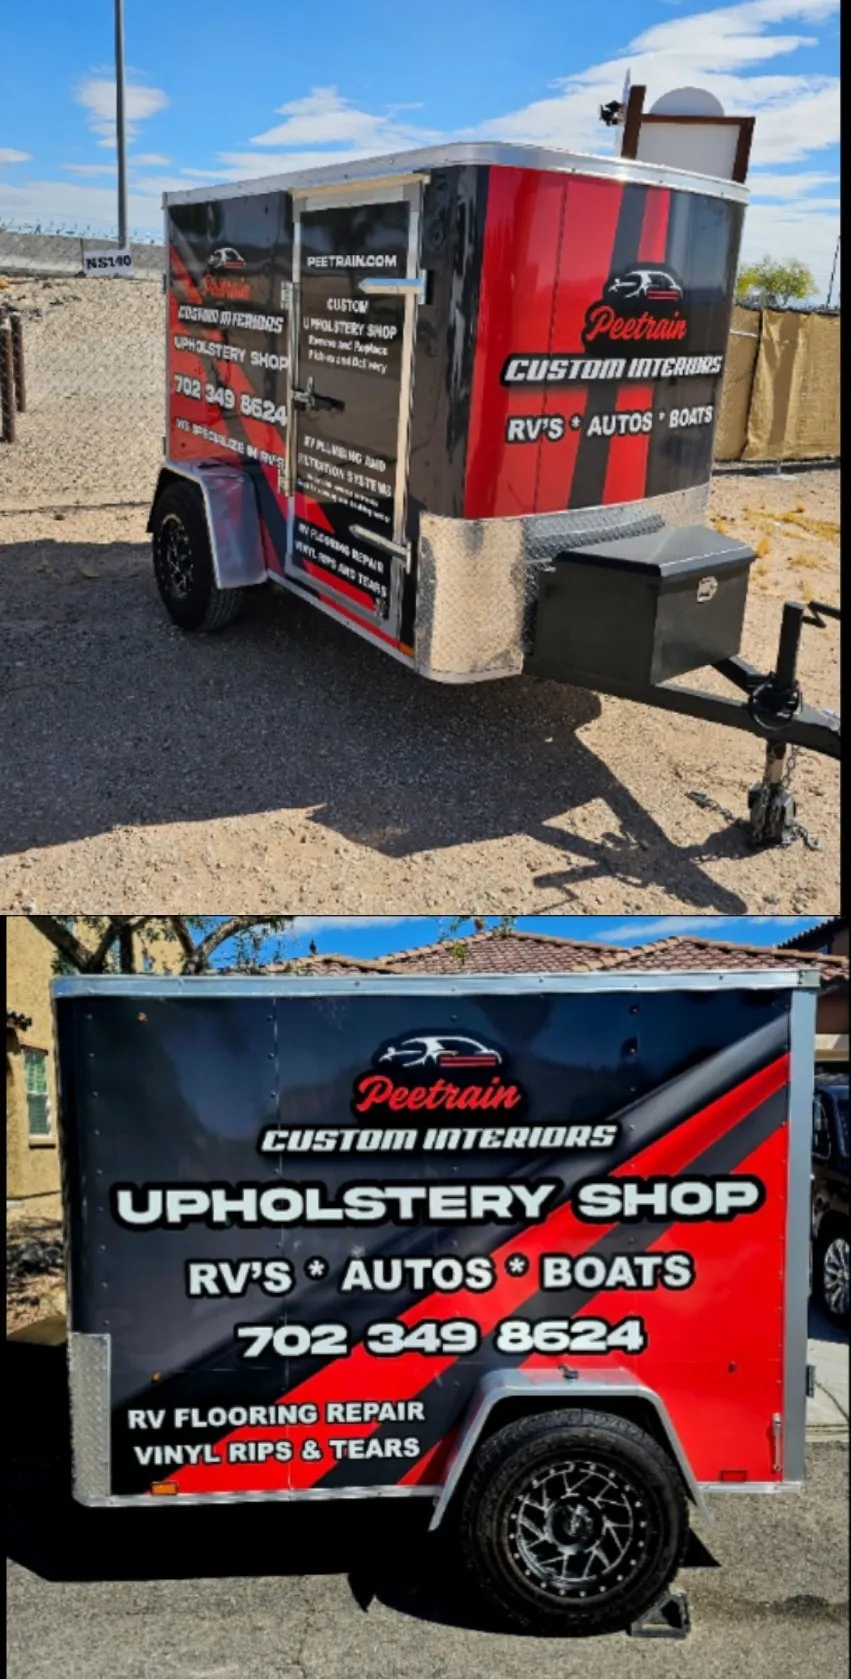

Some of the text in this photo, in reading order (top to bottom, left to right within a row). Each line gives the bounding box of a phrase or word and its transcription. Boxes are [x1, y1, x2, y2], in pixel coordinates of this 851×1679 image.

[86, 255, 131, 270] NS140
[307, 255, 397, 267] PEETRAIN.COM
[327, 298, 368, 313] CUSTOM
[303, 317, 397, 339] UPHOLSTERY SHOP
[586, 306, 687, 341] Peetrain
[174, 336, 290, 370] UPHOLSTERY SHOP
[504, 355, 723, 381] CUSTOM INTERIORS
[175, 375, 287, 426] 702 349 8624
[508, 405, 713, 440] RV'S AUTOS BOATS
[347, 470, 392, 497] SYSTEMS
[352, 548, 384, 573] REPAIR
[356, 1075, 521, 1112] Peetrain
[261, 1125, 618, 1152] CUSTOM INTERIORS
[117, 1181, 759, 1224] UPHOLSTERY SHOP
[189, 1254, 692, 1295] RV'S AUTOS BOATS
[238, 1320, 643, 1357] 702 349 8624
[128, 1402, 425, 1429] RV FLOORING REPAIR
[134, 1438, 420, 1465] VINYL RIPS & TEARS
